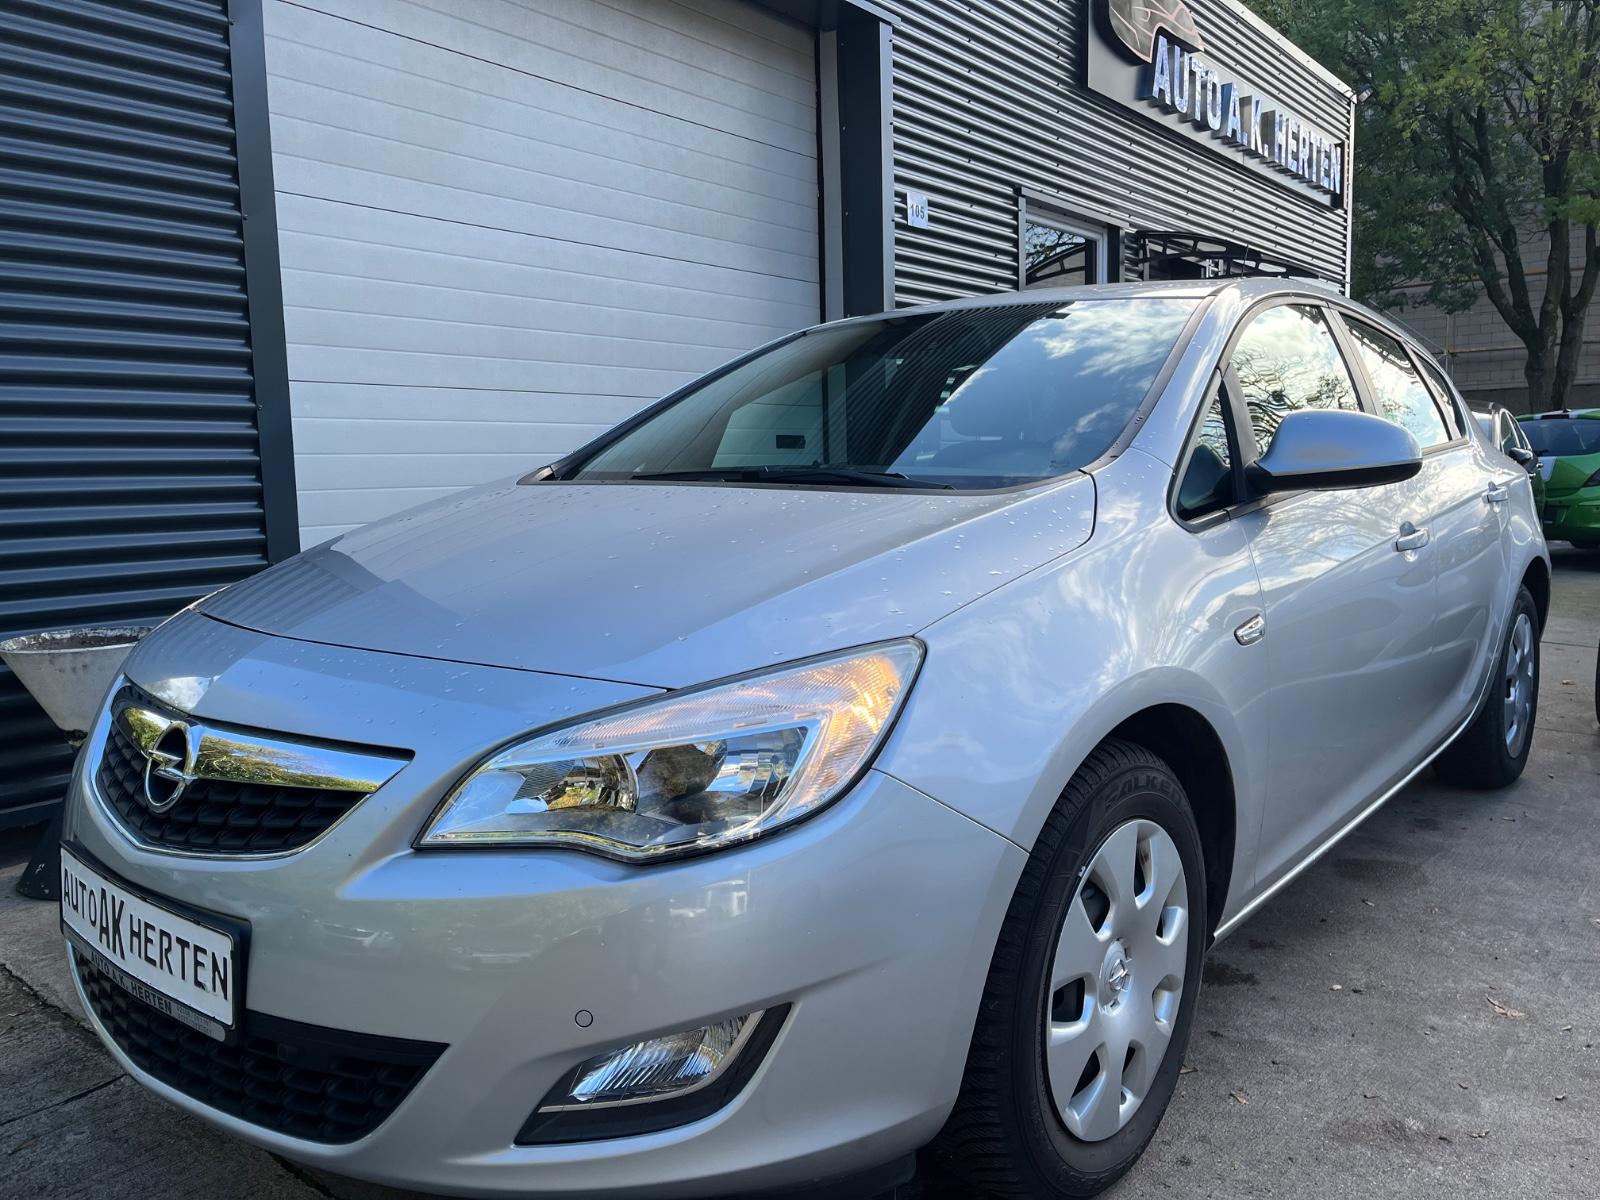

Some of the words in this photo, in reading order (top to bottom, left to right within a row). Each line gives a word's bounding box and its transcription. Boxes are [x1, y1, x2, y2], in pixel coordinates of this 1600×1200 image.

[1153, 35, 1221, 131] AUTO
[1274, 112, 1341, 194] HERTEN
[910, 203, 925, 220] 105
[129, 913, 228, 1001] HERTEN
[130, 981, 172, 1014] HERTEN
